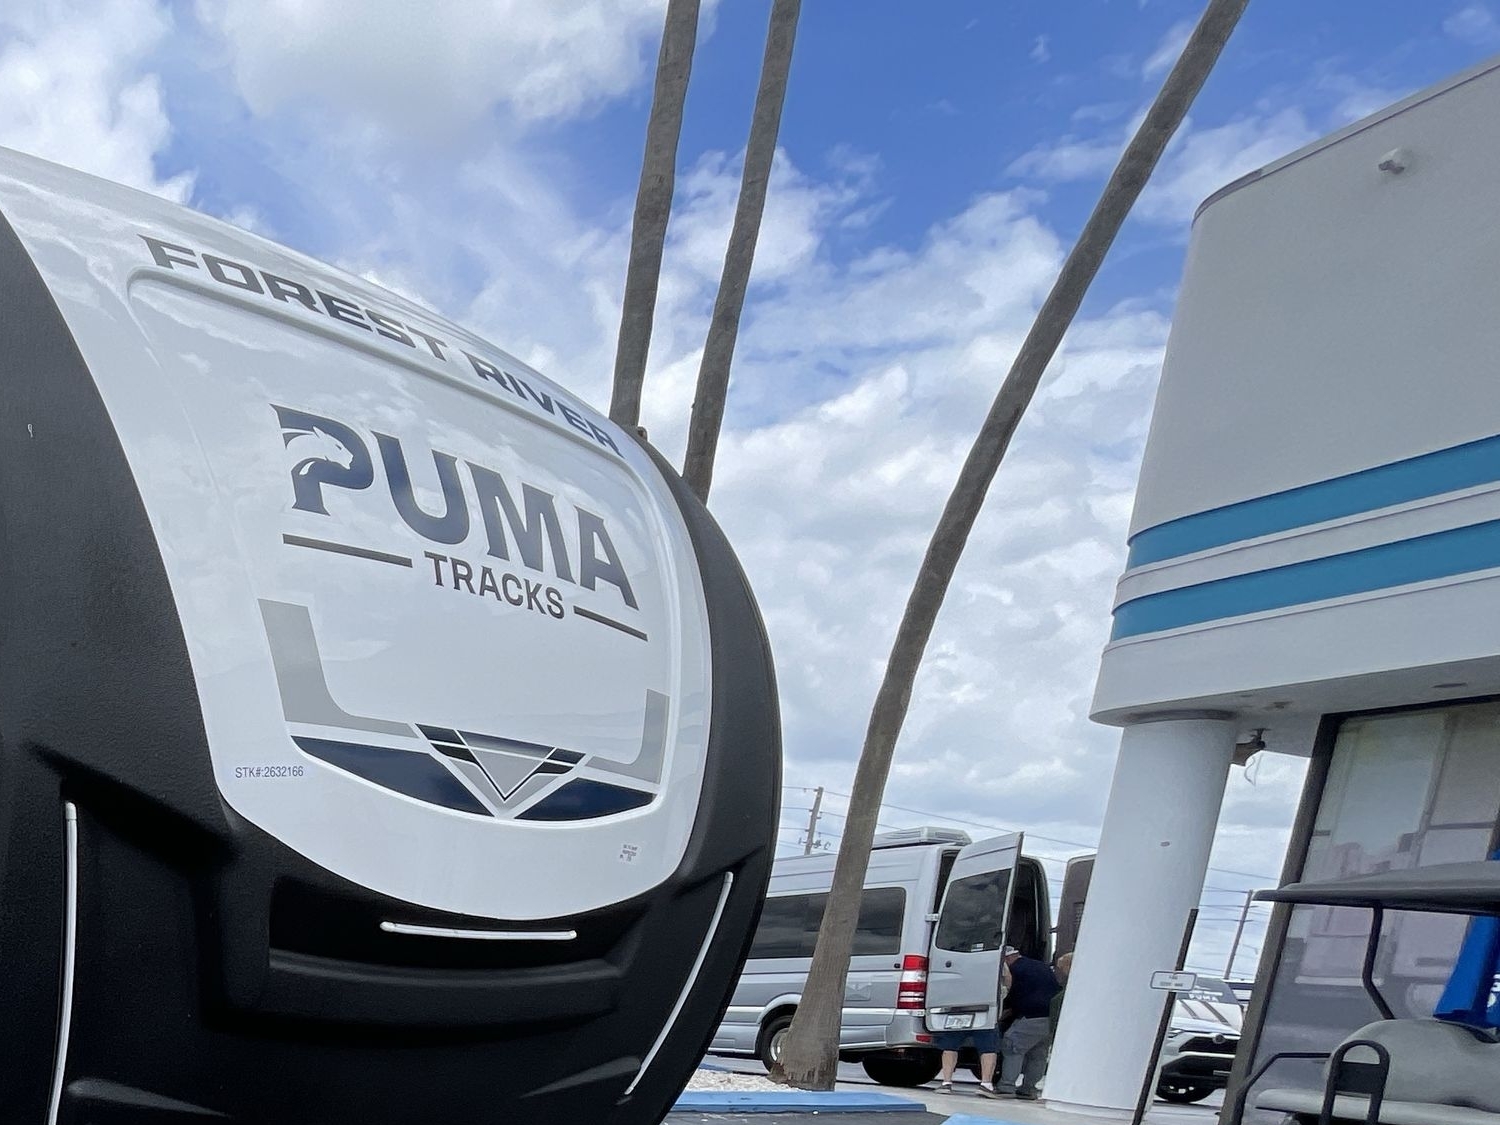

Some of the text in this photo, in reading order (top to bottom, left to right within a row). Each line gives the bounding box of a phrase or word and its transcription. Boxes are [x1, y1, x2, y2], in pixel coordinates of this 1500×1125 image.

[137, 234, 626, 460] FOREST RIVER
[269, 403, 640, 611] PUMA
[423, 550, 565, 620] TRACKS
[235, 765, 304, 779] STK#:2632166
